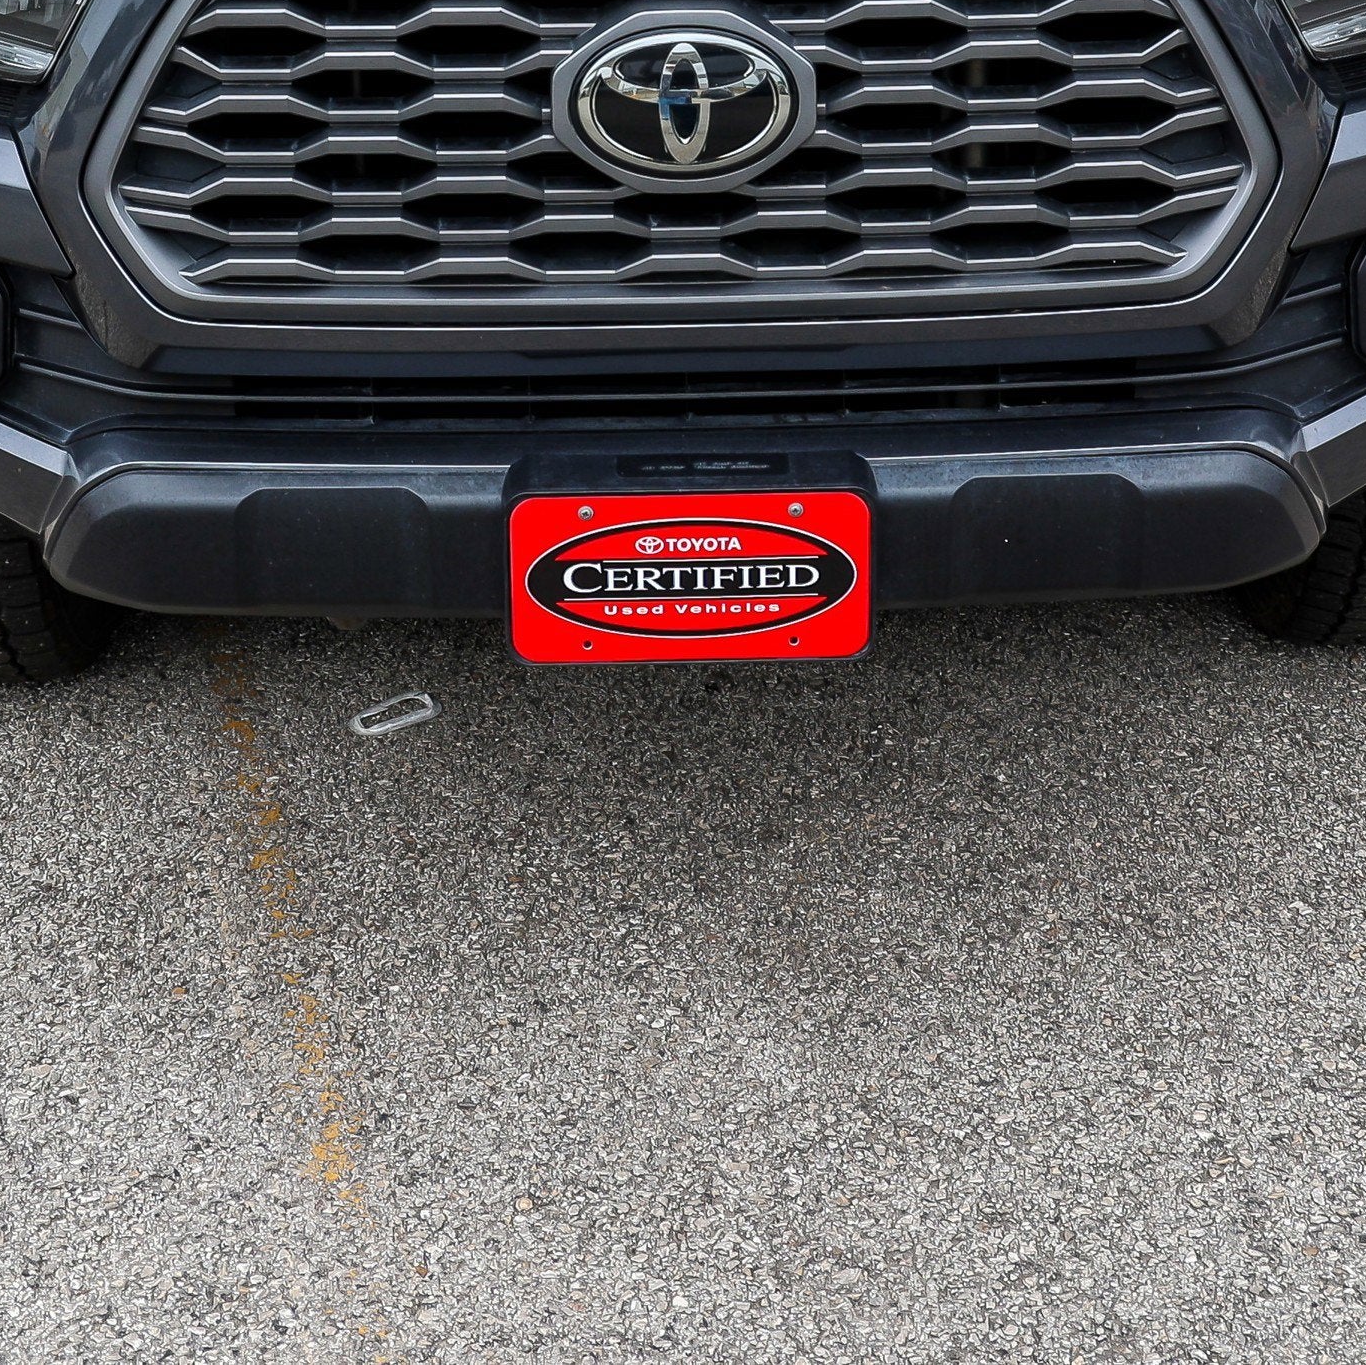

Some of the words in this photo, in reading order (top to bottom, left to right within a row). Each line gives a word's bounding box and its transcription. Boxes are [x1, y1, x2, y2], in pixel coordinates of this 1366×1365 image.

[665, 537, 742, 552] TOYOTA
[563, 562, 820, 593] CERTIFIED
[603, 604, 664, 616] Used
[675, 602, 781, 615] Vehicles
